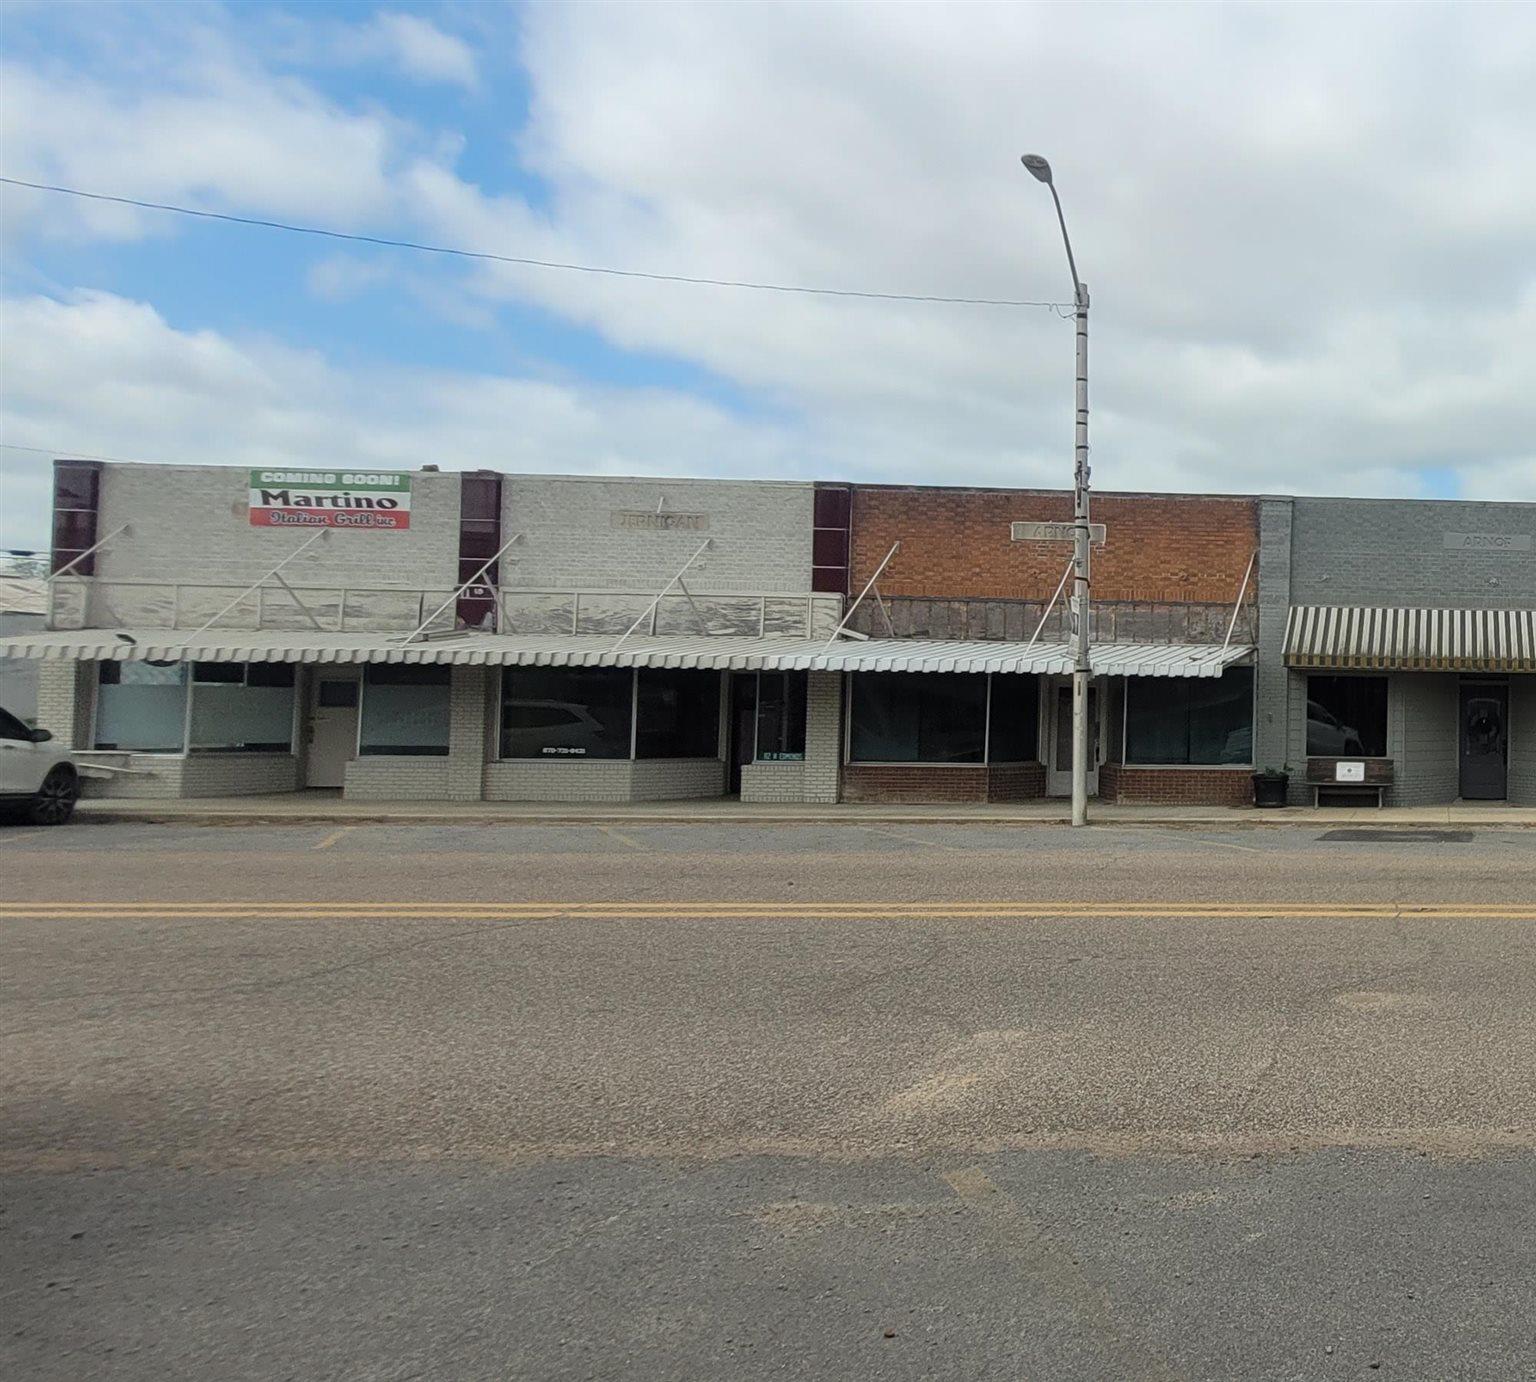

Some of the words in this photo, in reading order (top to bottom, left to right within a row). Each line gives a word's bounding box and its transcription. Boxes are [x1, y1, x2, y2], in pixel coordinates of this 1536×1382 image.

[260, 472, 336, 484] COMING
[341, 474, 400, 486] SOON!
[260, 489, 399, 510] Martino
[270, 511, 330, 525] Italian
[334, 513, 373, 527] Grill
